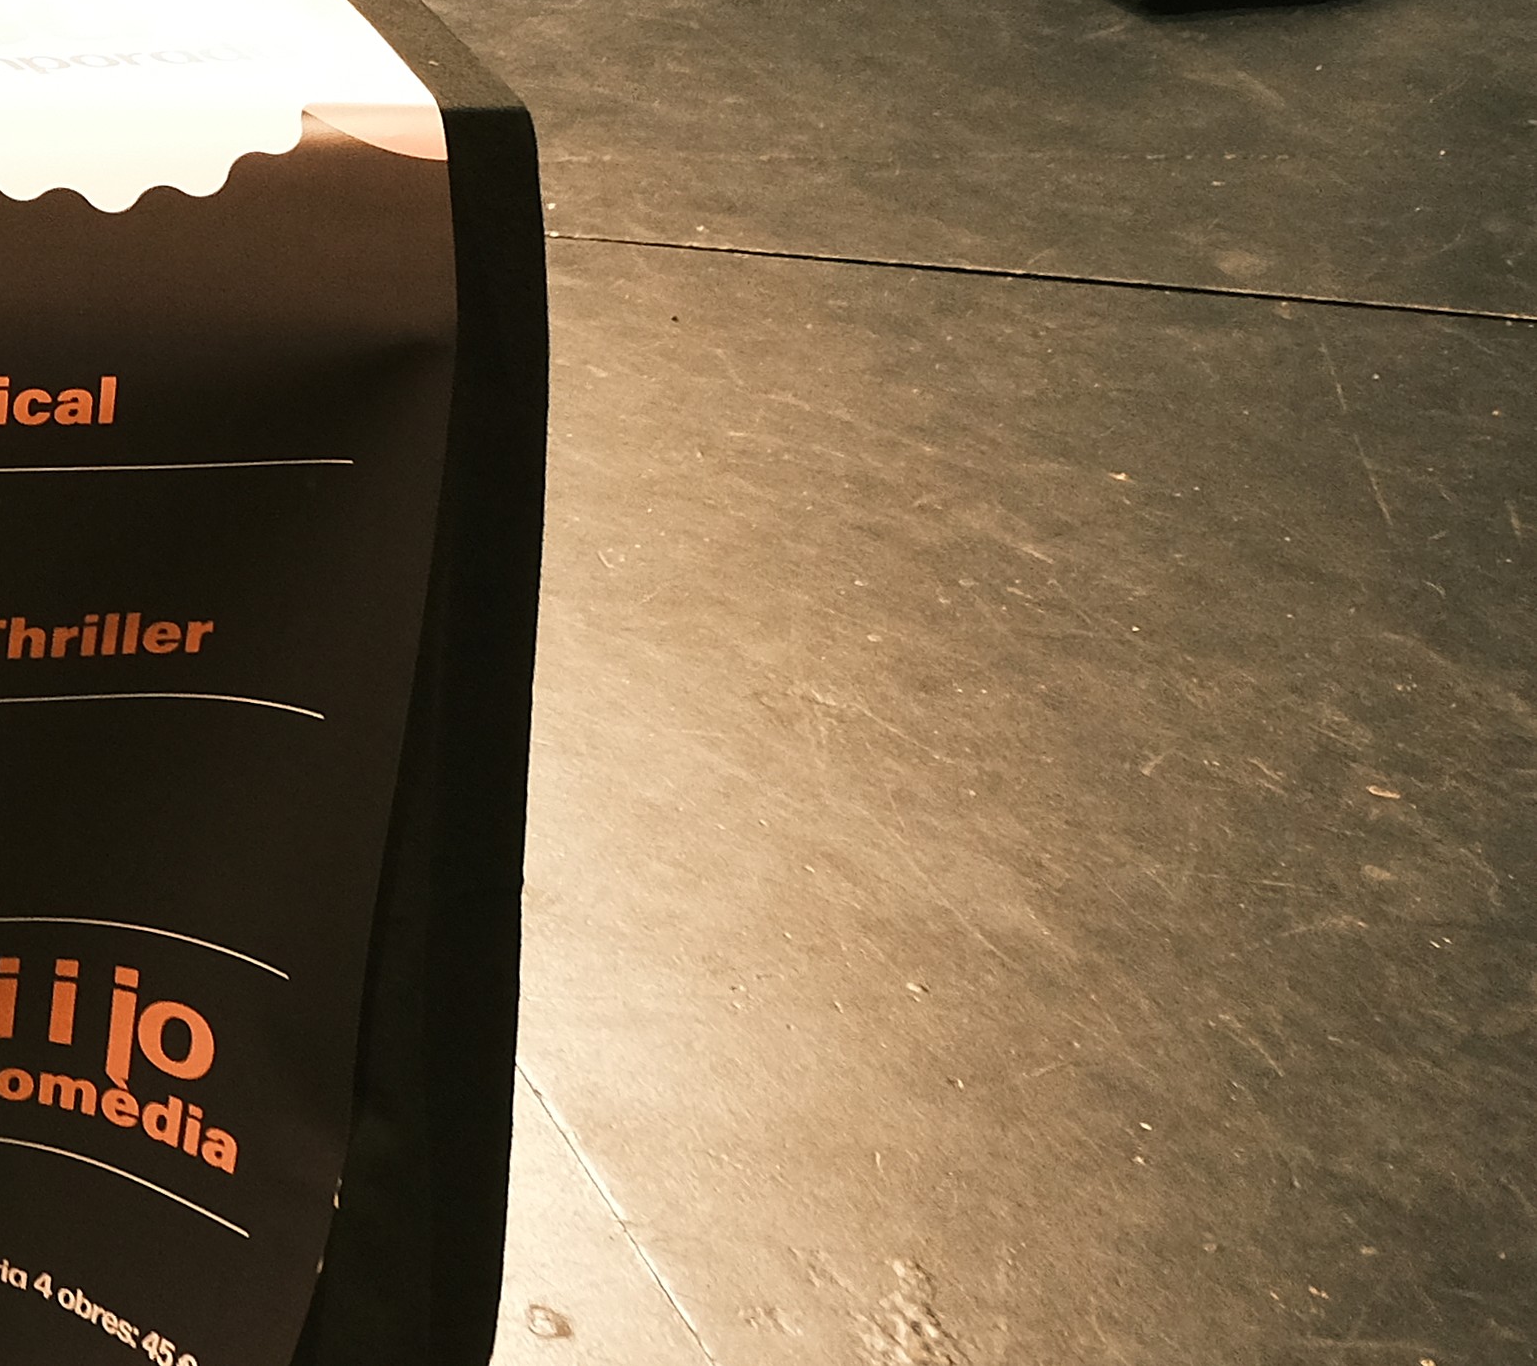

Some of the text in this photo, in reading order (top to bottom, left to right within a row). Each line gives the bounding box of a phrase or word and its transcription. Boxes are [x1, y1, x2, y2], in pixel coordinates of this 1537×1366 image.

[46, 957, 82, 1047] i
[102, 964, 218, 1083] jo
[32, 1271, 55, 1301] 4
[55, 1286, 142, 1351] obres:
